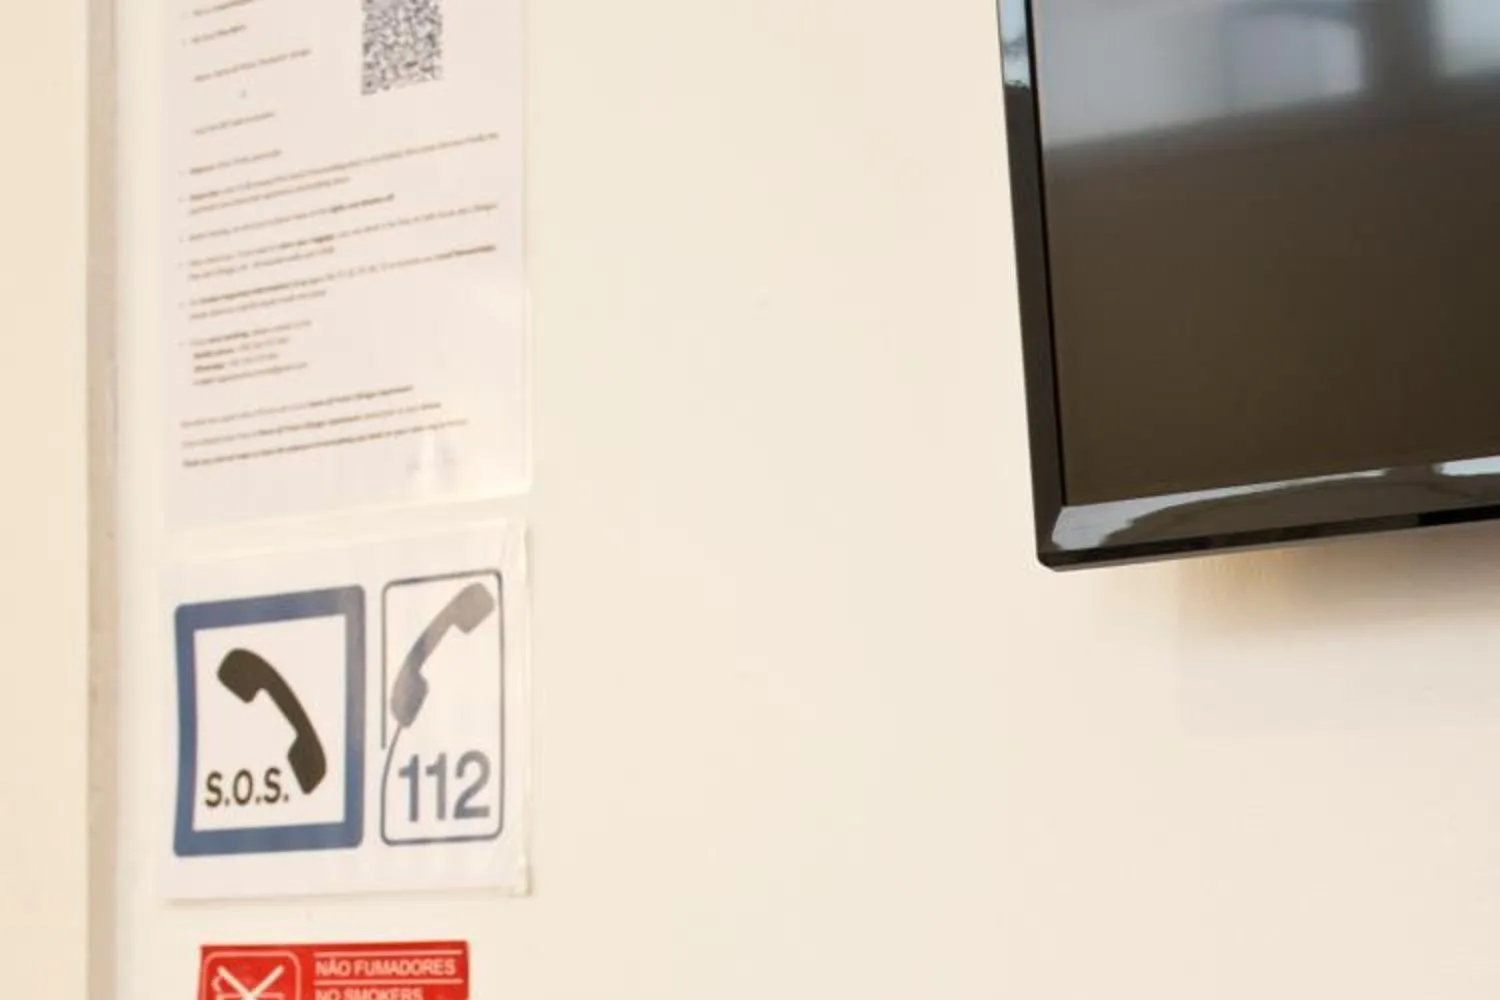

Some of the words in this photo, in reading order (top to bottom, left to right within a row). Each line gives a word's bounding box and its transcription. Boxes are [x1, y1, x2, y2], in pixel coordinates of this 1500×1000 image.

[204, 766, 290, 808] S.O.S.
[397, 749, 491, 823] 112
[315, 957, 351, 977] NÃO
[353, 958, 456, 976] FUMADORES
